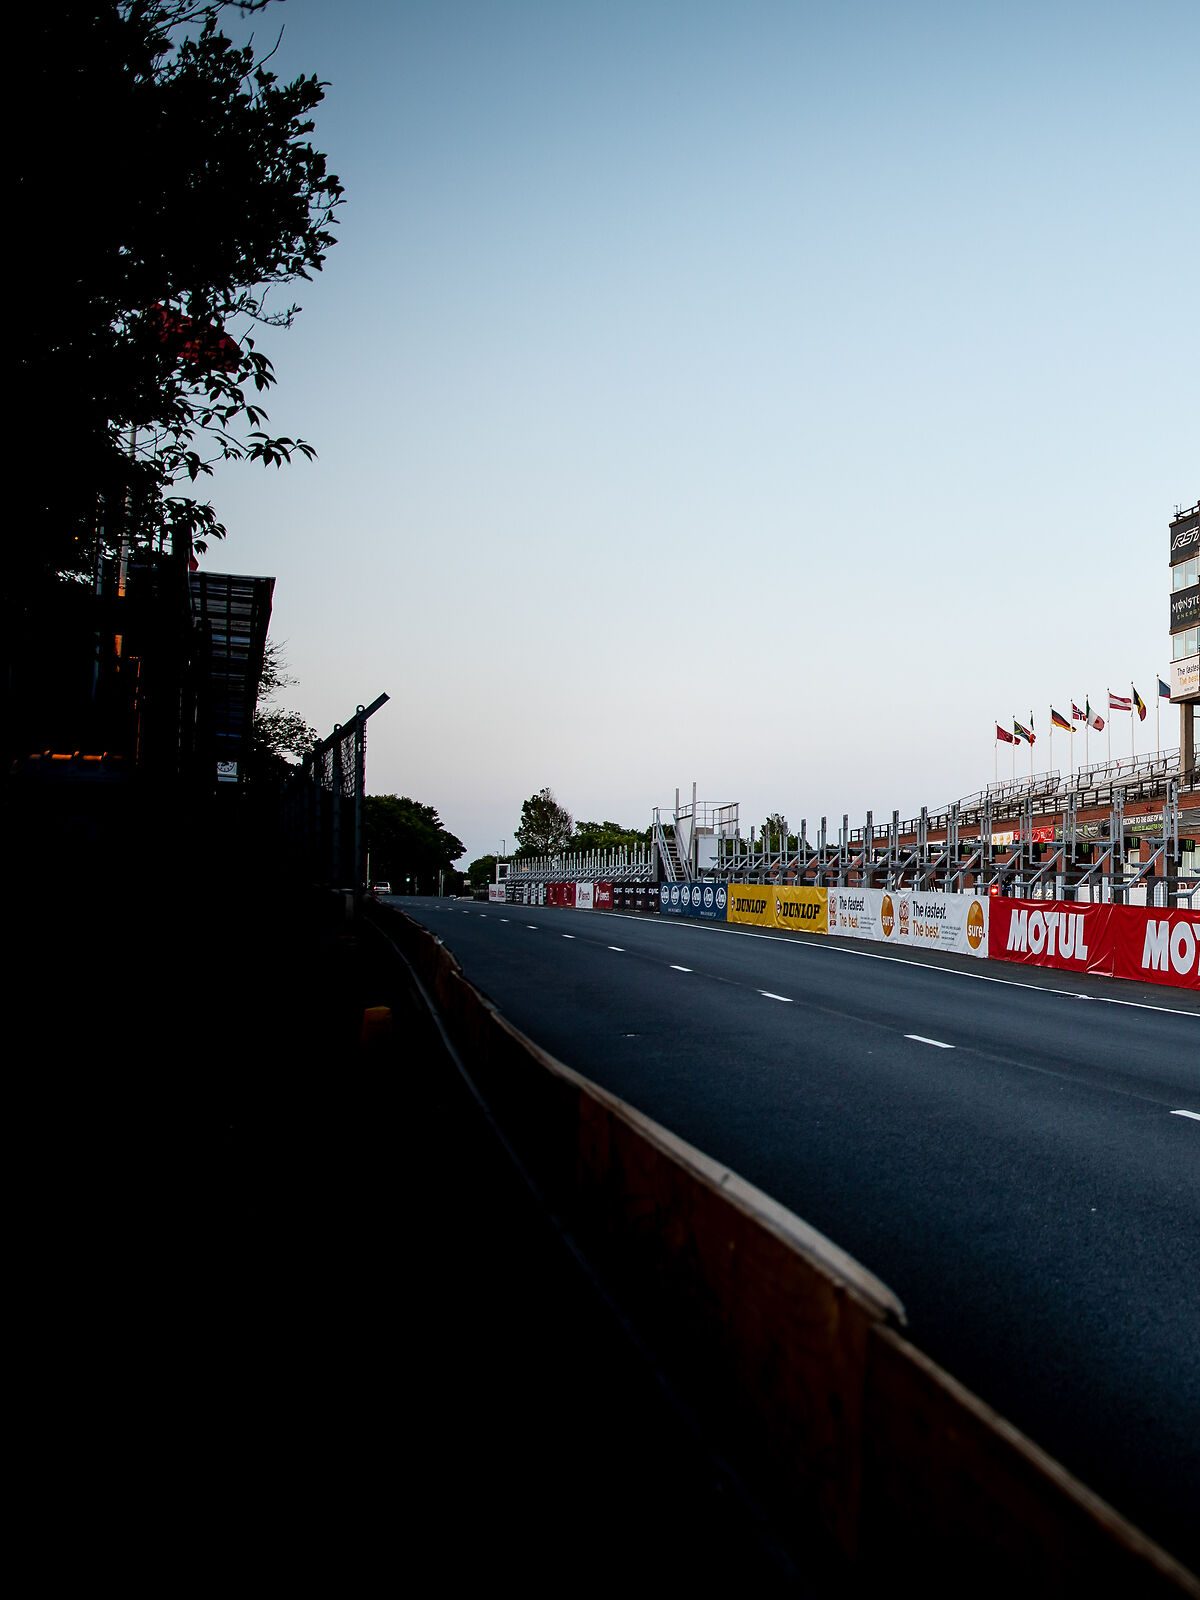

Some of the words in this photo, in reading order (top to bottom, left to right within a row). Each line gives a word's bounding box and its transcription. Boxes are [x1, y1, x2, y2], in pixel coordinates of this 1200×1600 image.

[1176, 608, 1200, 620] ENERG
[735, 898, 768, 915] DUNLOP
[782, 902, 821, 920] DUNLOP
[839, 896, 847, 911] The
[912, 900, 924, 918] The
[924, 902, 947, 920] fastest.
[839, 912, 847, 928] The
[912, 919, 924, 937] The
[925, 921, 940, 939] best.
[1006, 908, 1089, 961] MOTUL
